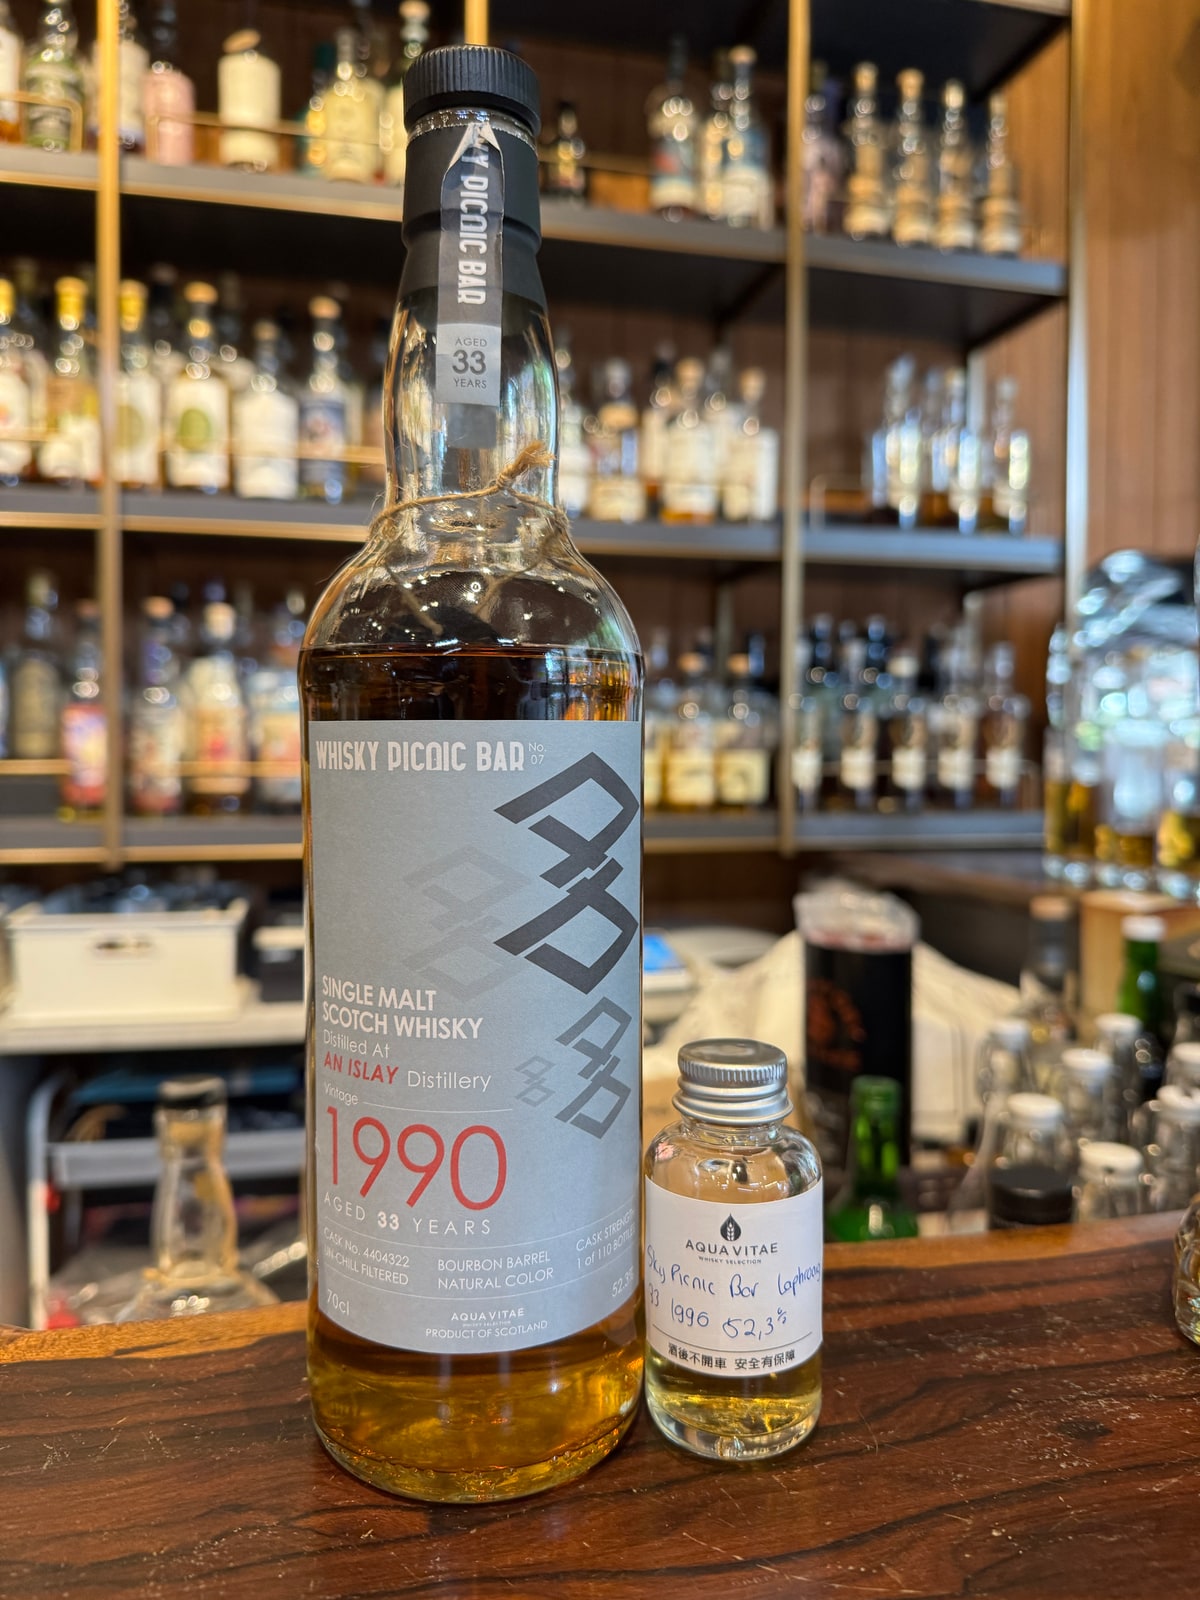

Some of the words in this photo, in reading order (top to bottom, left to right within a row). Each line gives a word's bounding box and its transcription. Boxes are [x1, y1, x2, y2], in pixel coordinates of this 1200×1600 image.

[457, 260, 488, 305] BAR
[455, 337, 487, 347] AGED
[452, 350, 487, 375] 33
[453, 378, 487, 389] YEARS
[316, 741, 379, 770] WHISKY
[388, 741, 467, 771] PICNIC
[476, 741, 525, 771] BAR
[528, 742, 547, 752] No.
[530, 755, 544, 765] 07
[322, 975, 374, 1007] SINGLE
[378, 986, 437, 1012] MALT
[322, 1001, 388, 1036] SCOTCH
[393, 1015, 484, 1040] WHISKY
[323, 1029, 367, 1055] Distilled
[372, 1042, 390, 1059] At
[324, 1051, 343, 1073] AN
[347, 1058, 399, 1085] ISLAY
[407, 1070, 492, 1093] Distillery
[324, 1082, 360, 1106] Vintage
[326, 1105, 508, 1212] 1990
[324, 1191, 366, 1221] AGED
[377, 1210, 400, 1231] 33
[412, 1218, 491, 1236] YEARS
[324, 1227, 343, 1247] CASK
[345, 1239, 361, 1256] No.
[363, 1248, 410, 1268] 4404322
[576, 1231, 602, 1251] CASK
[685, 1239, 729, 1256] AQUA
[732, 1242, 778, 1256] VITAE
[438, 1258, 502, 1272] BOURBON
[506, 1251, 551, 1269] BARREL
[585, 1251, 595, 1266] of
[698, 1255, 724, 1264] WHISKY
[361, 1264, 409, 1286] FILTERED
[438, 1277, 501, 1290] NATURAL
[505, 1267, 554, 1287] COLOR
[327, 1289, 350, 1316] 70cl
[451, 1311, 487, 1321] AQUA
[488, 1307, 525, 1320] VITAE
[425, 1328, 475, 1339] PRODUCT
[477, 1329, 492, 1338] OF
[495, 1320, 548, 1337] SCOTLAND
[668, 1342, 727, 1369] 酒後不開車
[734, 1349, 796, 1370] 安全有保障
